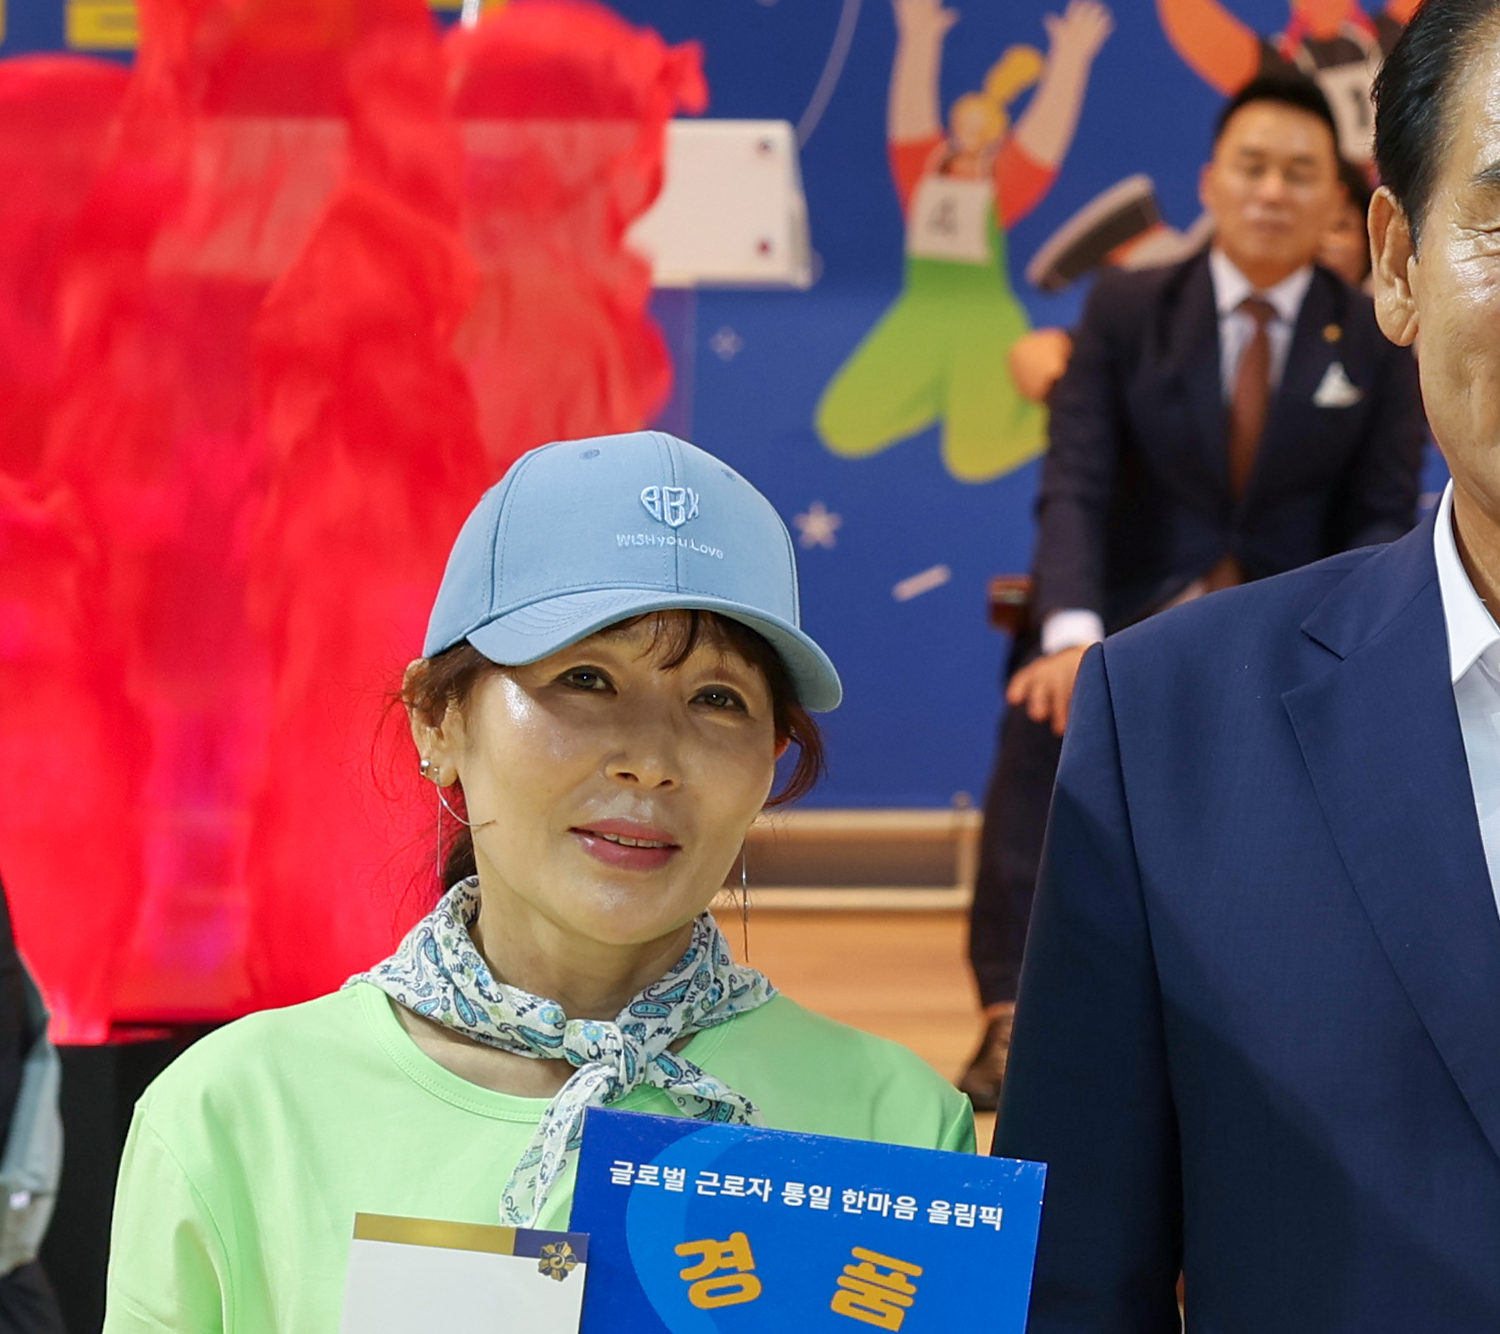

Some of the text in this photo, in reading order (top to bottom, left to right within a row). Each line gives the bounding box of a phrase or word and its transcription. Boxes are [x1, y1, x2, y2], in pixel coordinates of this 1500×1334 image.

[609, 1159, 1004, 1232] 글로벌 근로자 통일 한마음 올림픽
